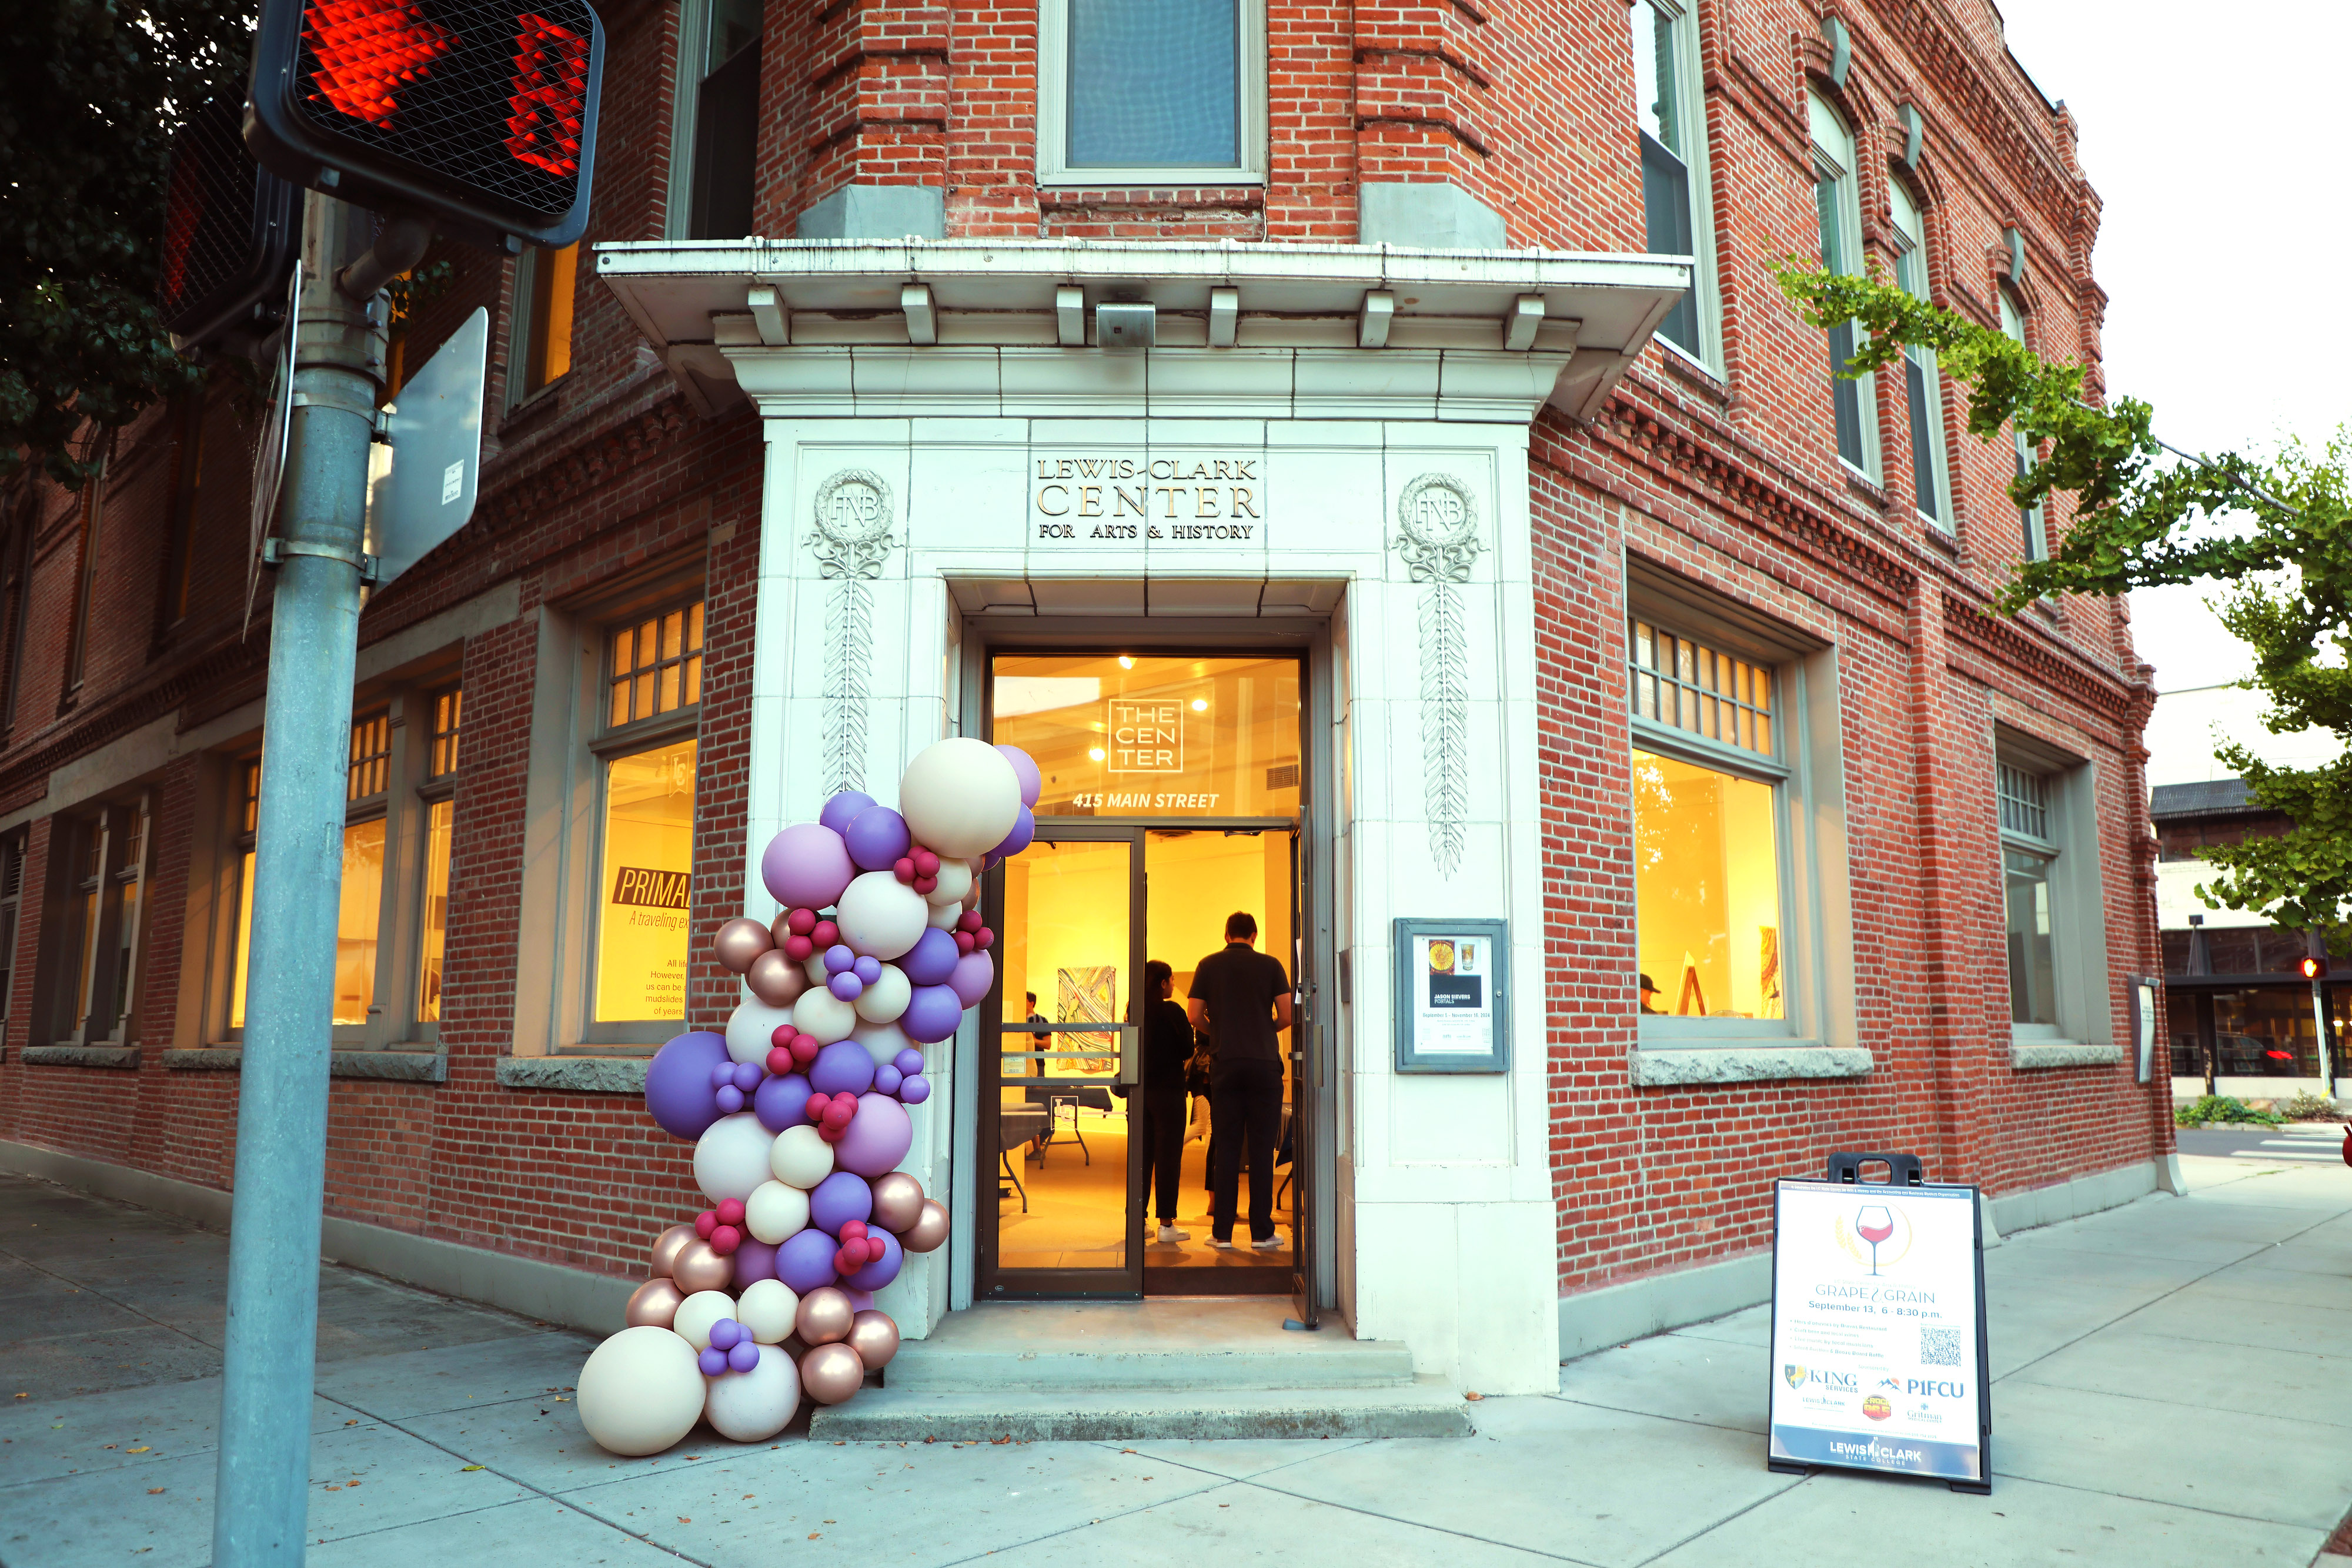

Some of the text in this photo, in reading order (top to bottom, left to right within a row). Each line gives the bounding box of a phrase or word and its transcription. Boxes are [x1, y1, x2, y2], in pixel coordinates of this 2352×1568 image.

[1037, 484, 1260, 518] CENTER
[1039, 524, 1253, 539] FOR ARTS & HISTORY
[1116, 707, 1175, 723] THE
[1115, 727, 1175, 744] CEN
[1117, 749, 1174, 766] TER
[1072, 793, 1220, 808] 415 MAIN STREET
[629, 910, 636, 925] A
[638, 912, 677, 931] traveling
[650, 971, 684, 980] However,
[672, 983, 681, 991] be
[646, 995, 683, 1003] mudslides
[654, 1007, 662, 1015] of
[1815, 1283, 1935, 1305] GRAPE & GRAIN
[1808, 1300, 1860, 1312] September
[1863, 1305, 1876, 1315] 13,
[1882, 1306, 1888, 1315] 6
[1896, 1307, 1919, 1317] 8:30
[1921, 1310, 1942, 1319] p.m.
[1809, 1369, 1858, 1387] KING
[1825, 1384, 1859, 1393] SERVICES
[1907, 1378, 1965, 1399] P1FCU
[1907, 1409, 1943, 1420] Gritman
[1829, 1441, 1923, 1463] LEWIS CLARK
[1870, 1457, 1906, 1466] COLLEGE
